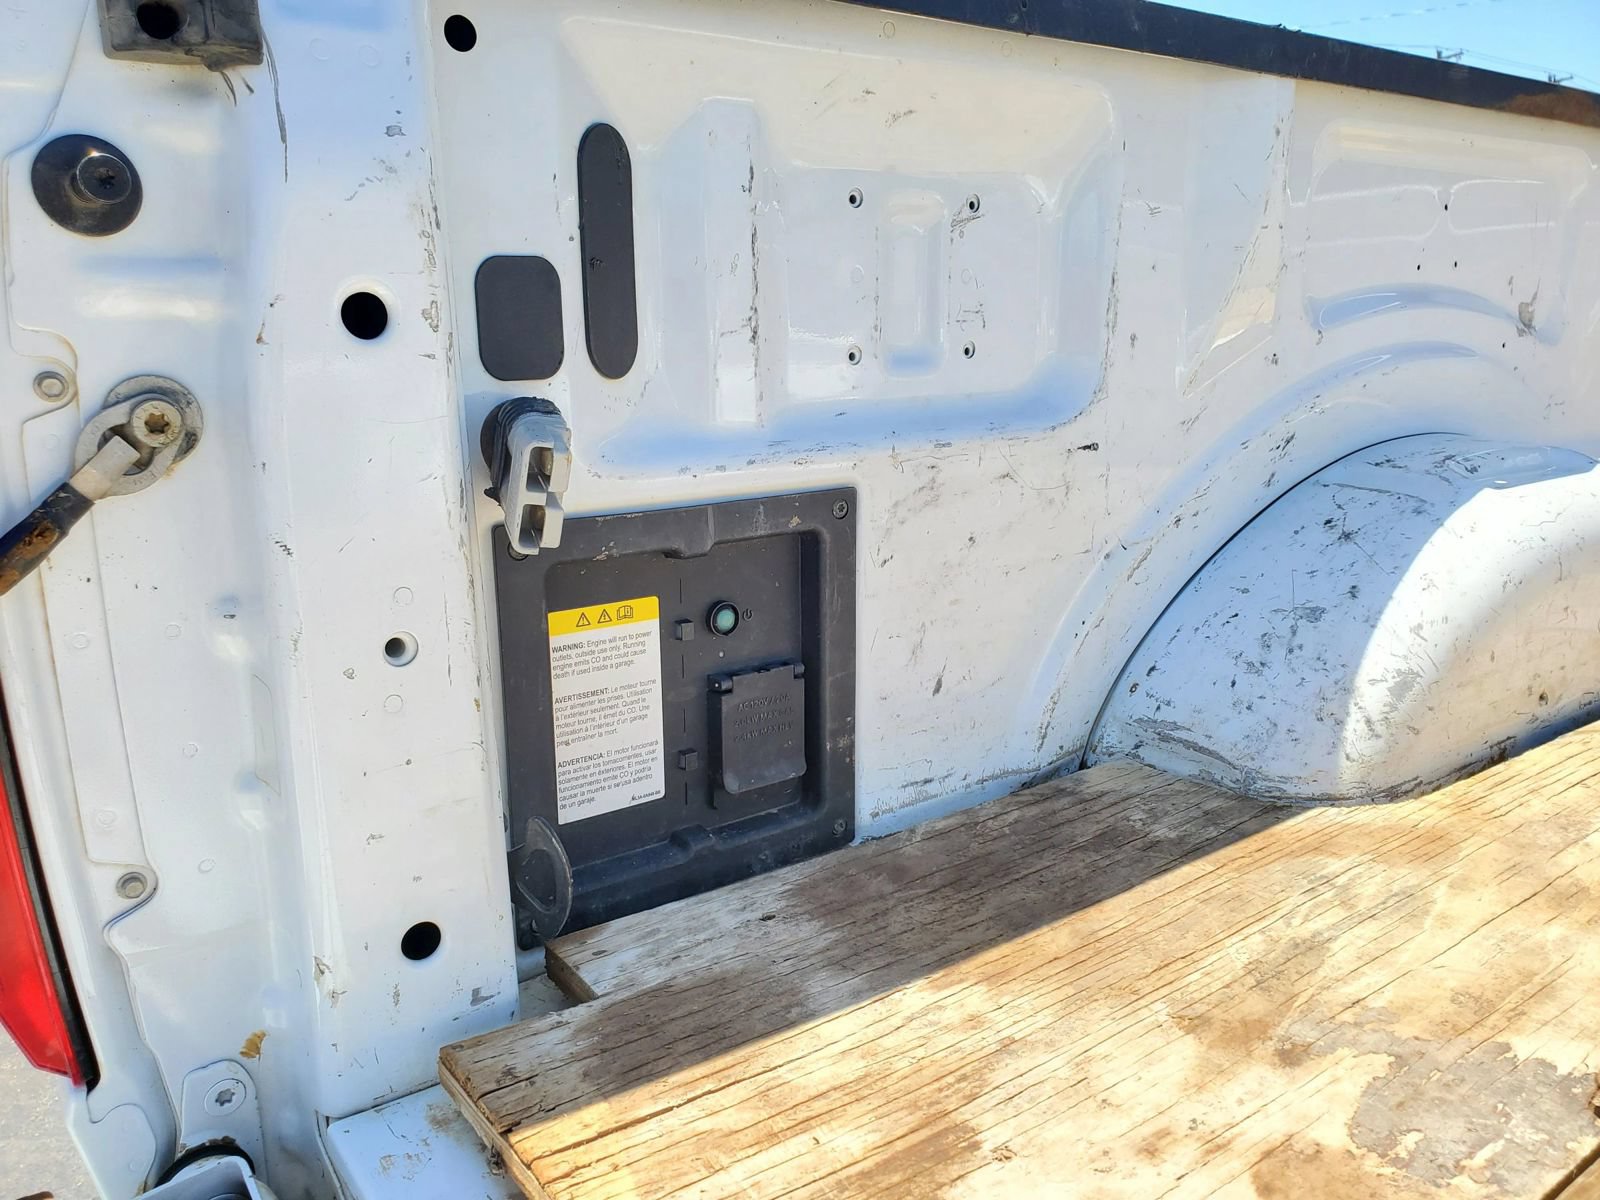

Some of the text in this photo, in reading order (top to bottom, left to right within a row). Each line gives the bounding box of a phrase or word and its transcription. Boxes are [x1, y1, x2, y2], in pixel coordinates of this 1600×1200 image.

[551, 642, 586, 654] WARNING:
[586, 639, 607, 648] Engine
[607, 636, 618, 644] will
[628, 633, 634, 641] to
[635, 630, 652, 640] power
[574, 649, 596, 659] outside
[596, 646, 608, 655] use
[622, 640, 646, 650] Running
[552, 648, 647, 672] engine emits CO and could cause
[552, 670, 570, 680] death
[571, 668, 576, 677] if
[576, 666, 591, 676] used
[591, 663, 609, 673] inside
[554, 678, 657, 704] AVERTISSEMENT: Le moteur tourne
[554, 705, 568, 714] pour
[569, 699, 597, 710] alimenter
[597, 697, 606, 705] les
[626, 687, 652, 699] Utilisation
[621, 698, 640, 708] Quand
[555, 719, 576, 730] moteur
[618, 709, 626, 717] du
[626, 706, 638, 715] CO.
[638, 704, 650, 712] Une
[556, 727, 583, 738] utilisation
[629, 713, 648, 723] garage
[597, 730, 603, 738] la
[557, 752, 605, 768] ADVERTENCIA:
[606, 749, 613, 758] El
[613, 747, 630, 756] motor
[557, 769, 571, 777] para
[572, 764, 592, 774] activar
[558, 773, 588, 785] solamente
[627, 761, 634, 769] El
[634, 758, 650, 767] motor
[558, 778, 602, 794] funcionamiento
[602, 774, 618, 783] emite
[619, 770, 629, 779] CO
[558, 792, 579, 802] causar
[586, 785, 606, 795] muerte
[620, 778, 632, 787] usa
[632, 773, 653, 784] adentro
[559, 803, 567, 811] de
[568, 801, 576, 809] un
